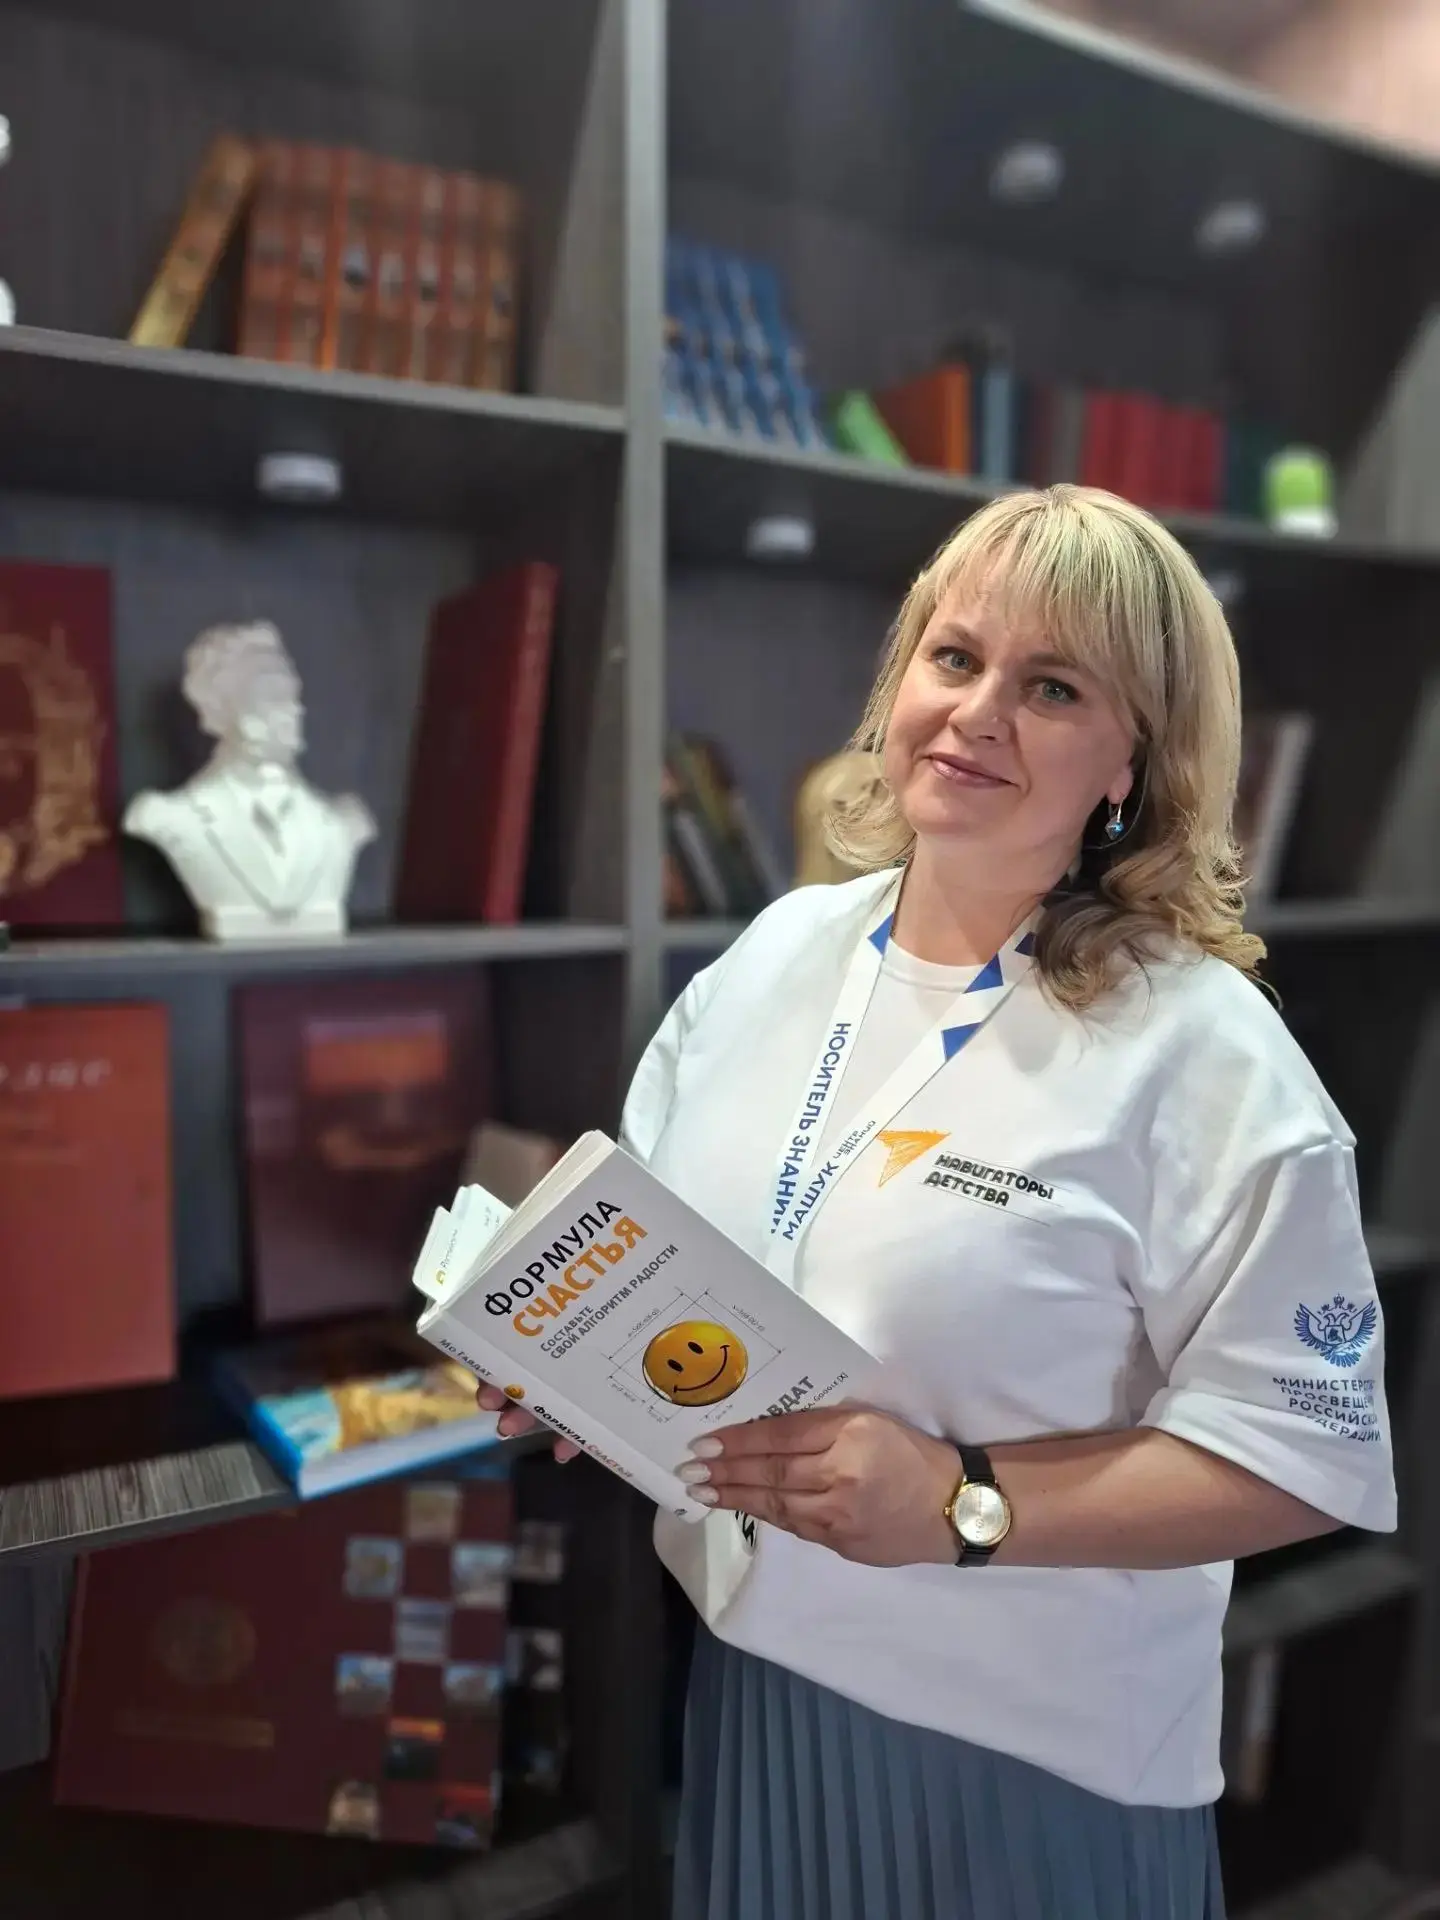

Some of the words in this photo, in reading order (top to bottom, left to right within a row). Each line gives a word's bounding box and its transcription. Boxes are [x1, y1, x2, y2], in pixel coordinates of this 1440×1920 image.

[799, 1023, 852, 1130] НОСИТЕЛЬ
[782, 1160, 840, 1241] МАШУК
[923, 1171, 1010, 1206] ДЕТСТВА
[934, 1154, 1054, 1200] НАВИГАТОРЫ
[484, 1200, 623, 1316] ФОРМУЛА
[512, 1216, 648, 1337] СЧАСТЬЯ
[540, 1305, 594, 1352] СОСТАВЬТЕ
[550, 1333, 581, 1359] СВОЙ
[577, 1287, 632, 1336] АЛГОРИТМ
[629, 1244, 679, 1289] РАДОСТИ
[534, 1405, 586, 1445] ФОРМУЛА
[746, 1376, 814, 1424] ВДАТ
